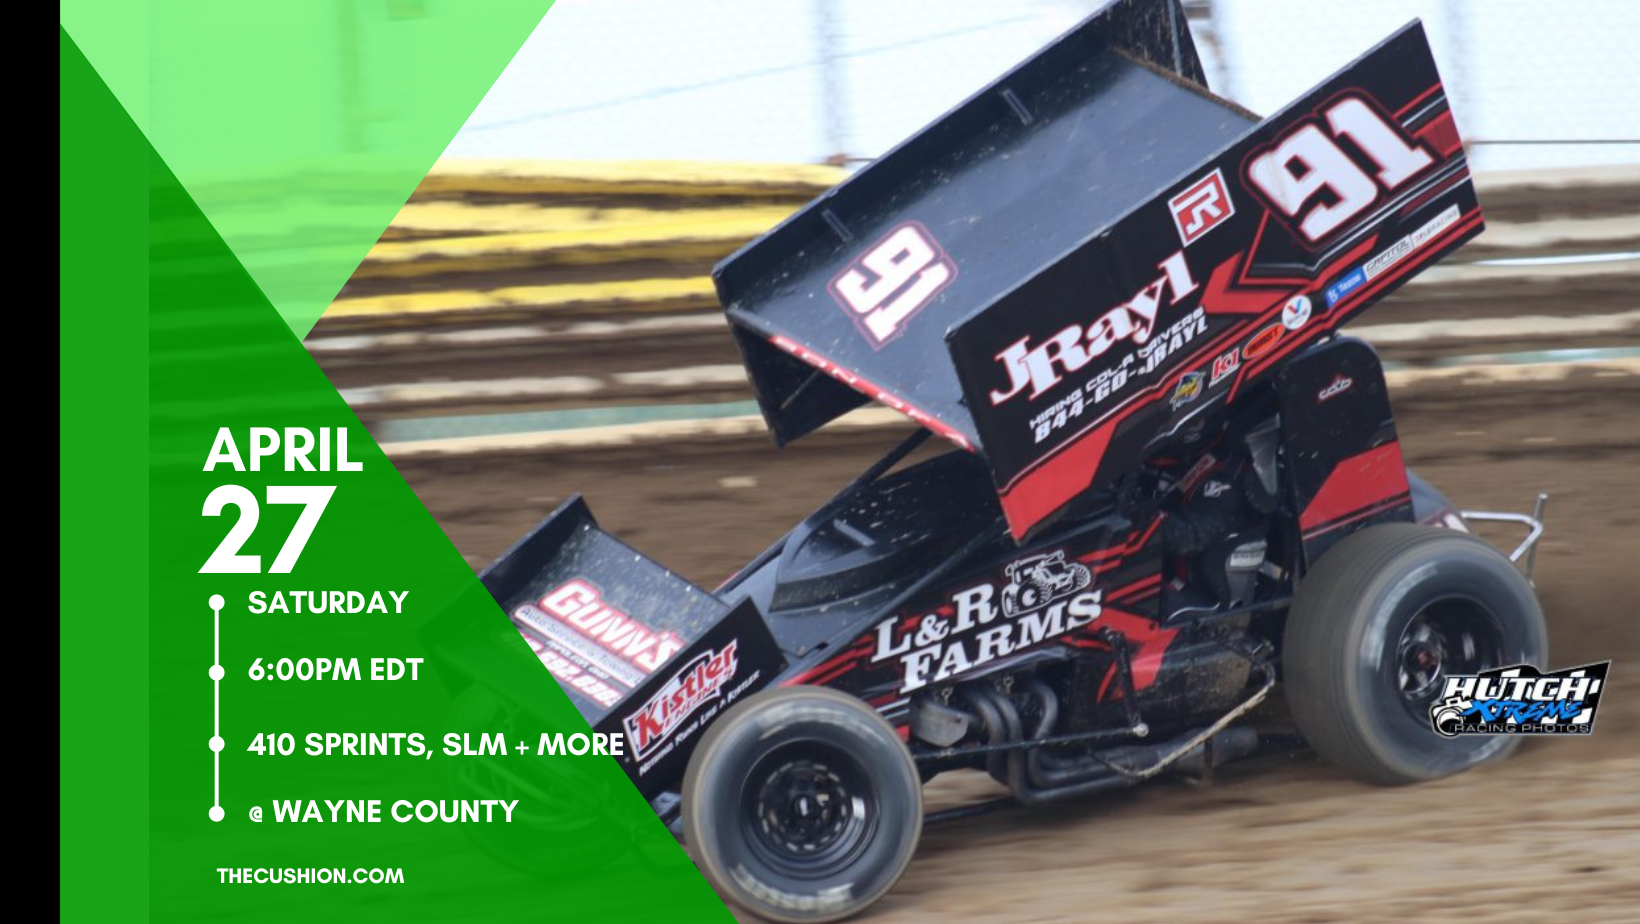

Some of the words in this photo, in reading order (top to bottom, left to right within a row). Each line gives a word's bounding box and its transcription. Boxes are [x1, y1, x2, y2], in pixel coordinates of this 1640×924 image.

[1249, 98, 1434, 241] 91
[836, 226, 949, 342] 91
[989, 250, 1199, 406] JRayl
[1029, 388, 1083, 430] HIRING
[1034, 320, 1209, 444] 844-GO-JRAYL
[871, 584, 998, 663] L&R
[900, 590, 1102, 694] FARMS
[635, 642, 737, 750] Kistler
